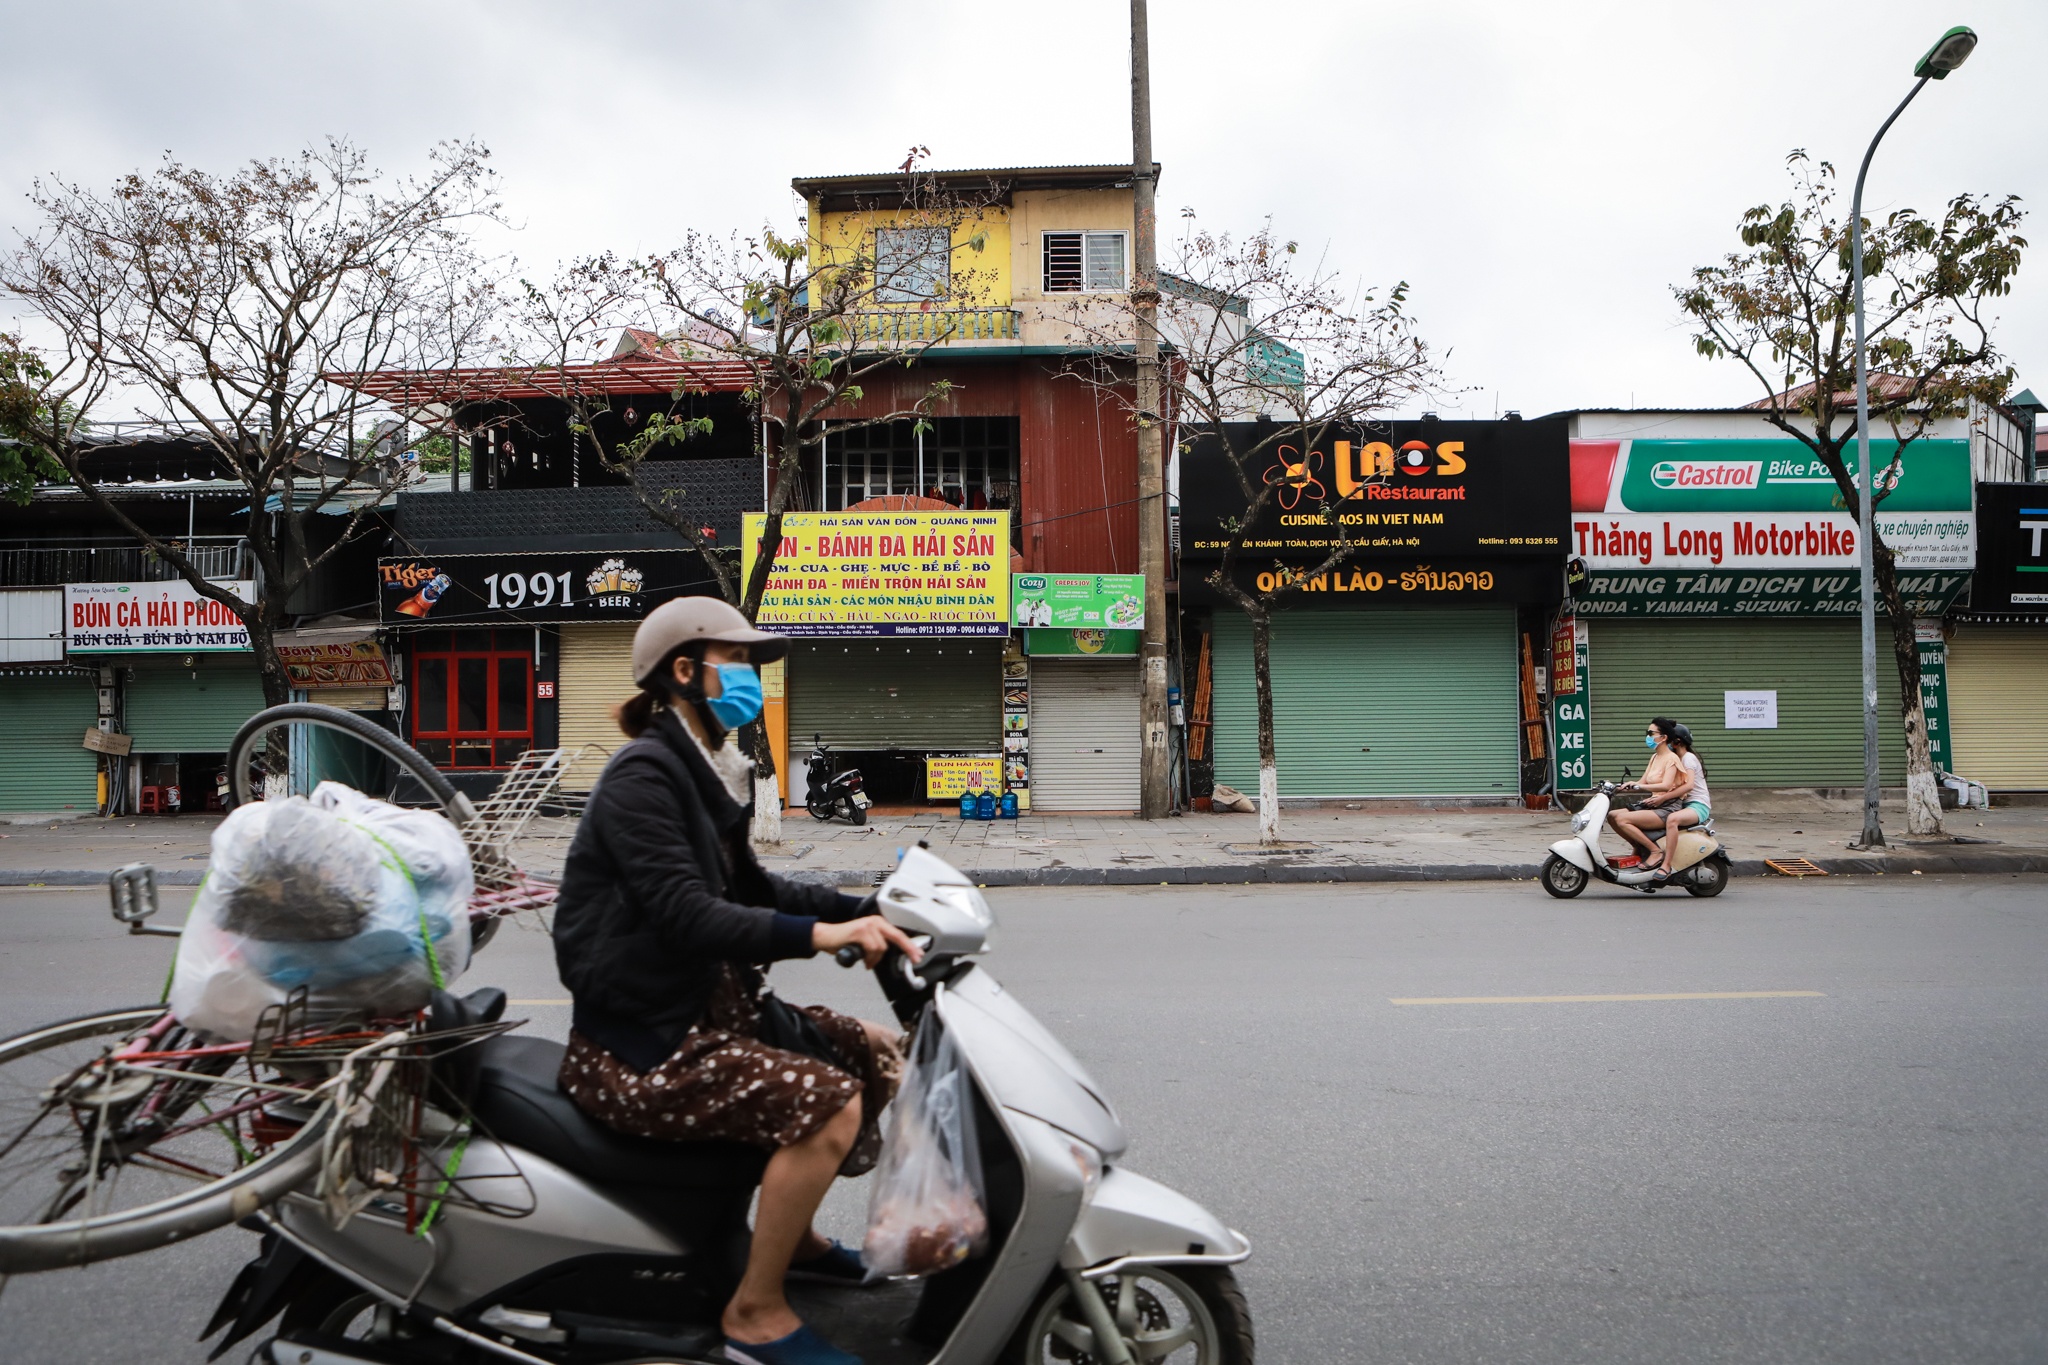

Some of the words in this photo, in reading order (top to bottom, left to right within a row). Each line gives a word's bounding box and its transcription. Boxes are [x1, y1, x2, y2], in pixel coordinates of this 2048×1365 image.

[1677, 465, 1754, 486] Castrol
[1768, 459, 1805, 477] Bike
[1367, 485, 1466, 500] Restaurant
[1366, 514, 1379, 525] IN
[1382, 514, 1409, 525] VIET
[1412, 513, 1444, 525] NAM
[1882, 523, 1895, 535] xe
[1896, 519, 1932, 540] chuyên
[818, 531, 873, 557] BÁNH
[912, 528, 946, 557] HẢI
[953, 528, 994, 557] SẢN
[1255, 539, 1282, 548] KHÁNH
[1574, 521, 1652, 565] Thăng
[1663, 521, 1723, 565] Long
[1733, 521, 1855, 556] Motorbike
[379, 563, 437, 589] Tiger
[800, 564, 829, 573] CUA
[808, 579, 827, 590] ĐA
[1021, 578, 1044, 588] Cozy
[1333, 566, 1382, 592] LÀO
[1588, 577, 1667, 595] RUNG
[1675, 573, 1734, 595] TÂM
[1736, 576, 1805, 599] DỊCH
[1811, 576, 1850, 598] VỤ
[1899, 573, 1961, 594] MÁY
[484, 571, 575, 609] 1991
[600, 596, 630, 608] BEER
[841, 594, 865, 605] CÁC
[868, 594, 894, 605] MÓN
[1645, 600, 1722, 614] YAMAHA
[1733, 599, 1802, 613] SUZUKI
[73, 597, 111, 628] BÚN
[117, 597, 141, 627] CÁ
[147, 593, 177, 627] HẢI
[884, 611, 919, 621] NGAO
[895, 626, 918, 634] Hotline:
[918, 626, 933, 634] 0912
[934, 626, 945, 634] 124
[946, 626, 957, 634] 509
[961, 626, 976, 634] 0904
[976, 626, 988, 634] 661
[538, 684, 553, 696] 55
[1559, 703, 1585, 720] GA
[1927, 718, 1938, 730] XE
[1560, 733, 1585, 749] XE
[1561, 754, 1586, 778] SỐ
